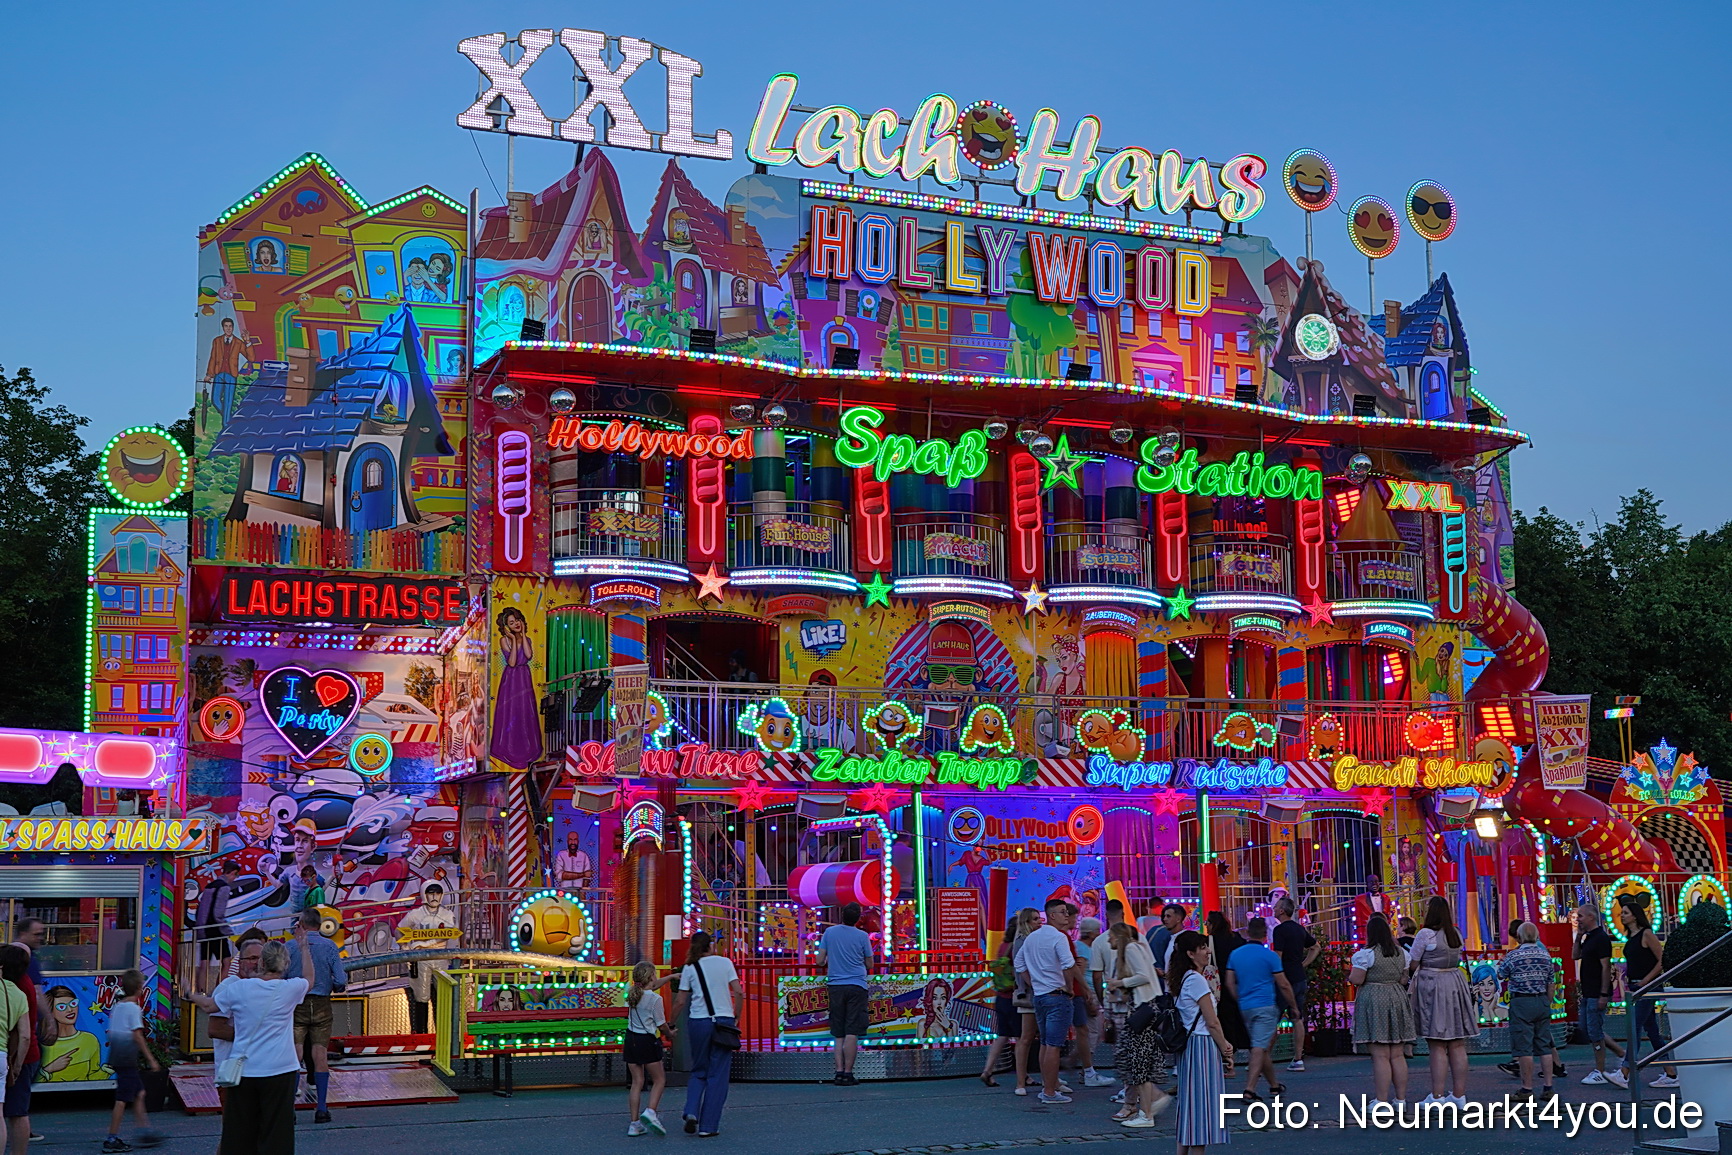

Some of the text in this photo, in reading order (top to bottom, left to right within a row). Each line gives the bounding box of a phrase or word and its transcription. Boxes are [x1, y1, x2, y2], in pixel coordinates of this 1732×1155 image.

[457, 28, 733, 160] XXL
[747, 72, 1267, 223] Lach Haus
[810, 204, 1212, 317] HOLLYWOOD
[547, 416, 755, 460] Hollywood
[834, 405, 1324, 500] Spaß Station
[1386, 480, 1464, 514] XXL
[600, 514, 647, 532] XXL
[766, 528, 829, 542] Fun House
[936, 543, 985, 559] MACHT
[1085, 553, 1136, 565] SUPER
[1235, 560, 1272, 574] GUTE
[1367, 569, 1415, 581] LAUNE
[228, 579, 461, 620] LACHSTRASSE
[598, 585, 655, 598] TOLLE-ROLLE
[782, 599, 815, 607] SHAKER
[933, 604, 988, 617] SUPER-RUTSCHE
[1085, 610, 1136, 626] ZAUBERTREPPE
[1234, 616, 1281, 630] TIME-TUNNEL
[933, 641, 970, 650] LACH HAUS
[283, 676, 300, 702] I
[618, 676, 643, 688] HIER
[278, 705, 344, 735] Party
[1541, 705, 1582, 715] HIER
[1541, 715, 1586, 726] Ab 21:00 Uhr
[577, 741, 759, 779] Shw Time
[811, 748, 931, 783] Zauber
[1086, 753, 1289, 792] Super Rutsche
[1333, 755, 1494, 791] Gaudi Show
[1544, 762, 1586, 784] Spaßbrille
[16, 820, 105, 849] SPASS
[113, 820, 182, 849] HAUS
[983, 815, 1068, 840] OLLYWOOD
[988, 840, 1078, 867] BOULEVARD
[412, 930, 453, 939] EINGANG
